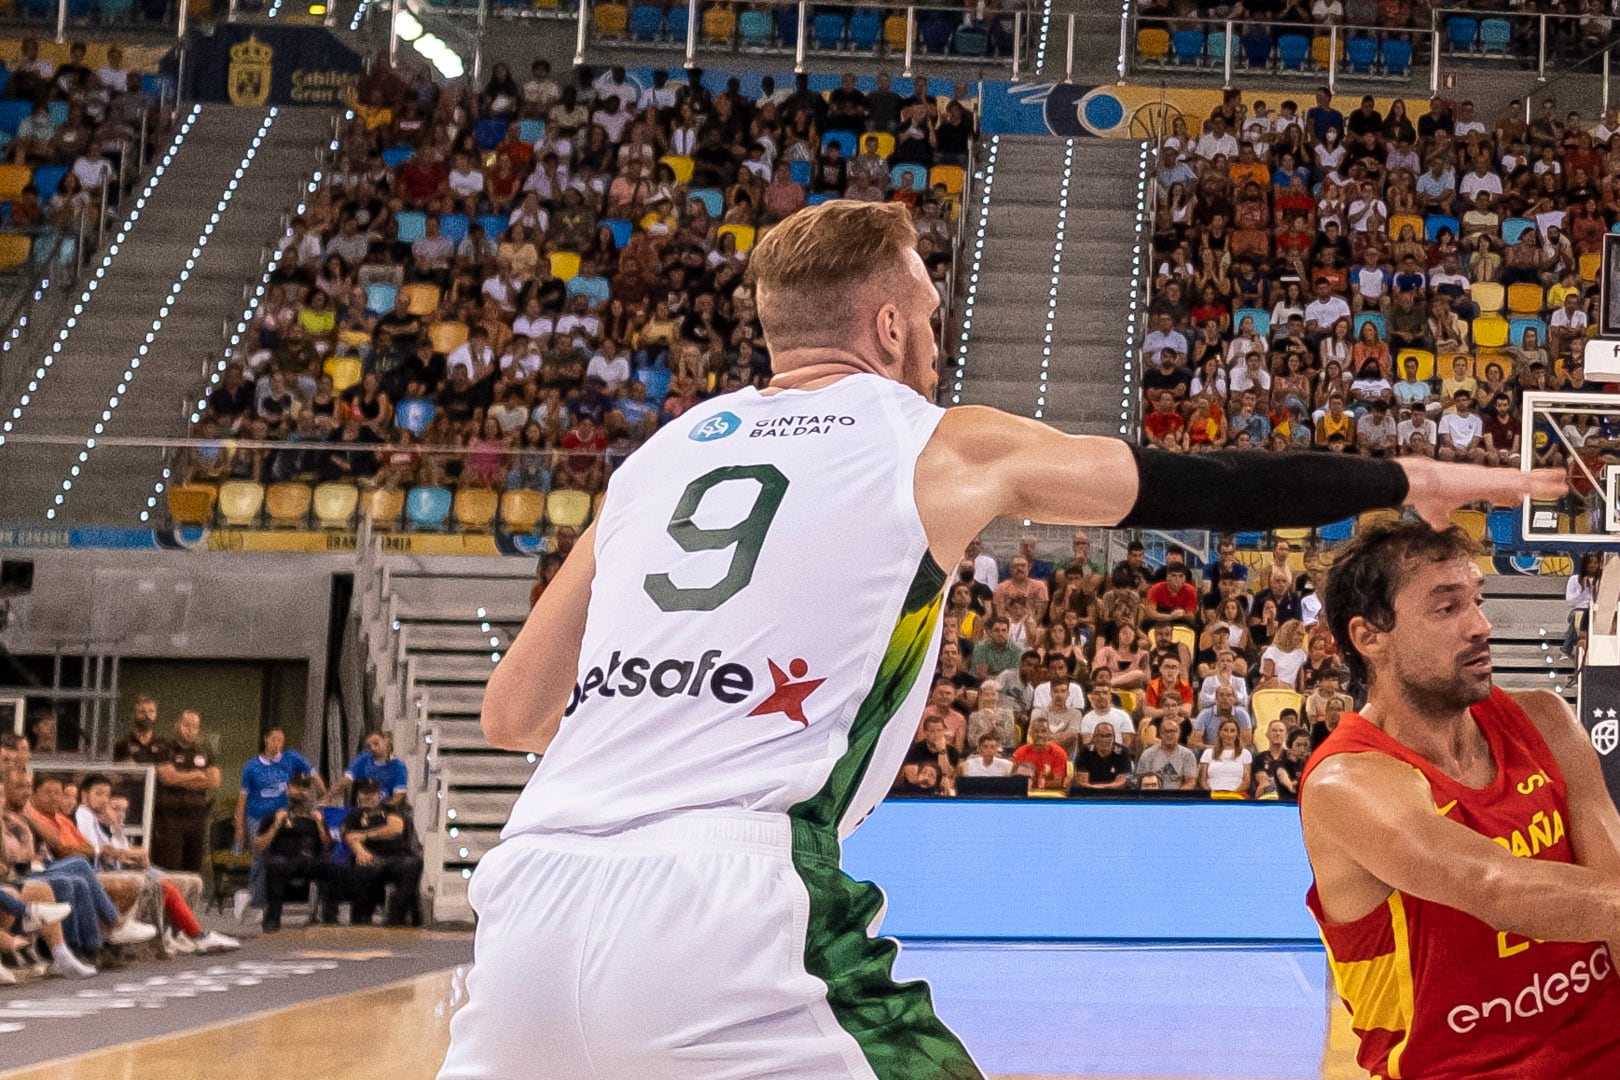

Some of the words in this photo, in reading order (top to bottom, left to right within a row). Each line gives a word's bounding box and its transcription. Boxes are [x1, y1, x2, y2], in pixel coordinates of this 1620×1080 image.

[748, 425, 831, 438] BALDAI
[755, 415, 856, 427] GINTARO
[643, 463, 791, 612] 9
[1447, 945, 1611, 1033] endesa
